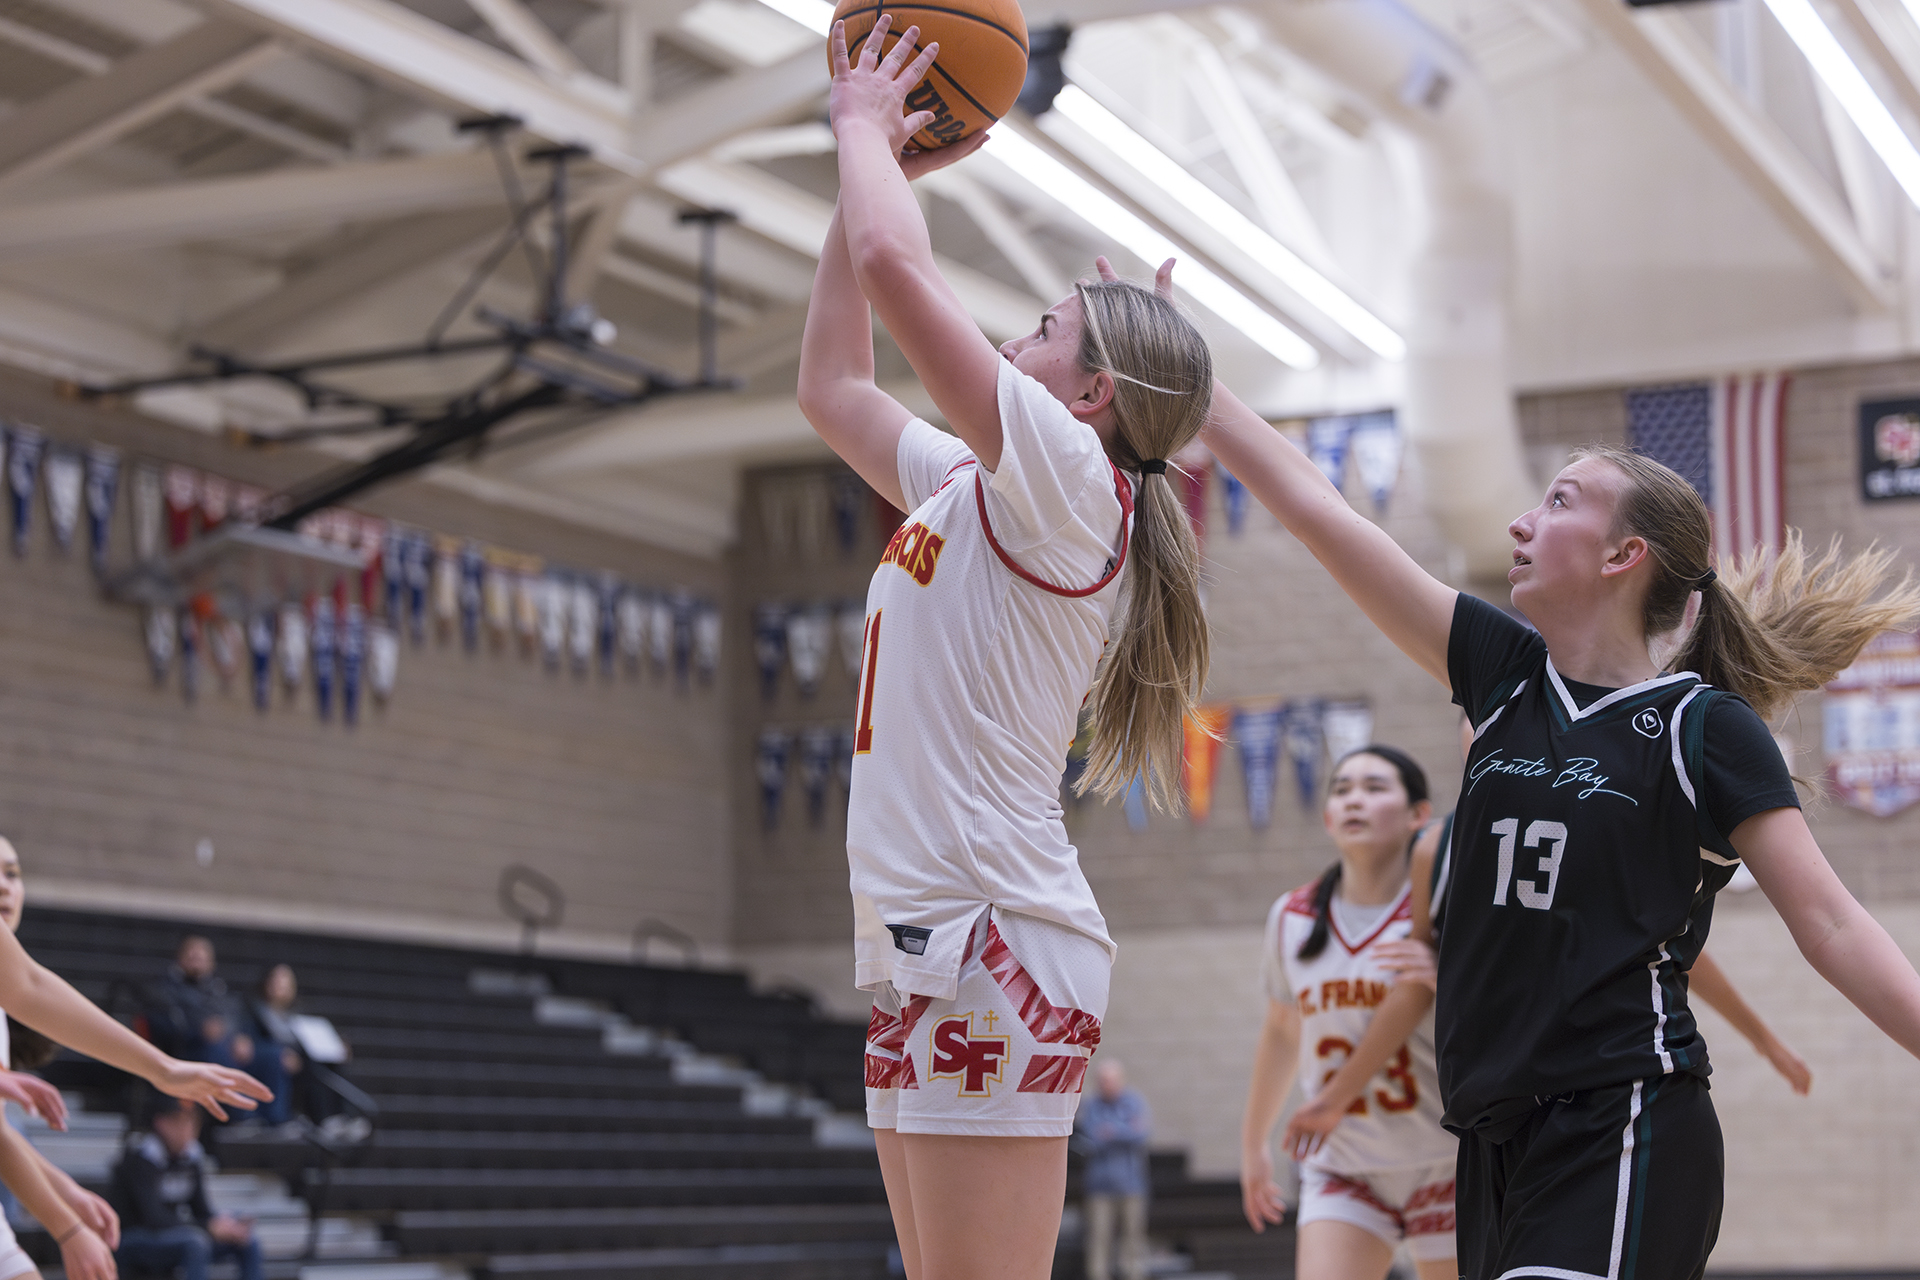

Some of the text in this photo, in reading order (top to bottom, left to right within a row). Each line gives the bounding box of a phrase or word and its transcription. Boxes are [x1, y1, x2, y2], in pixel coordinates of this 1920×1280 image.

[904, 79, 966, 143] Wils
[1552, 757, 1638, 806] Bay
[1491, 817, 1568, 911] 13
[932, 1018, 1005, 1092] SF
